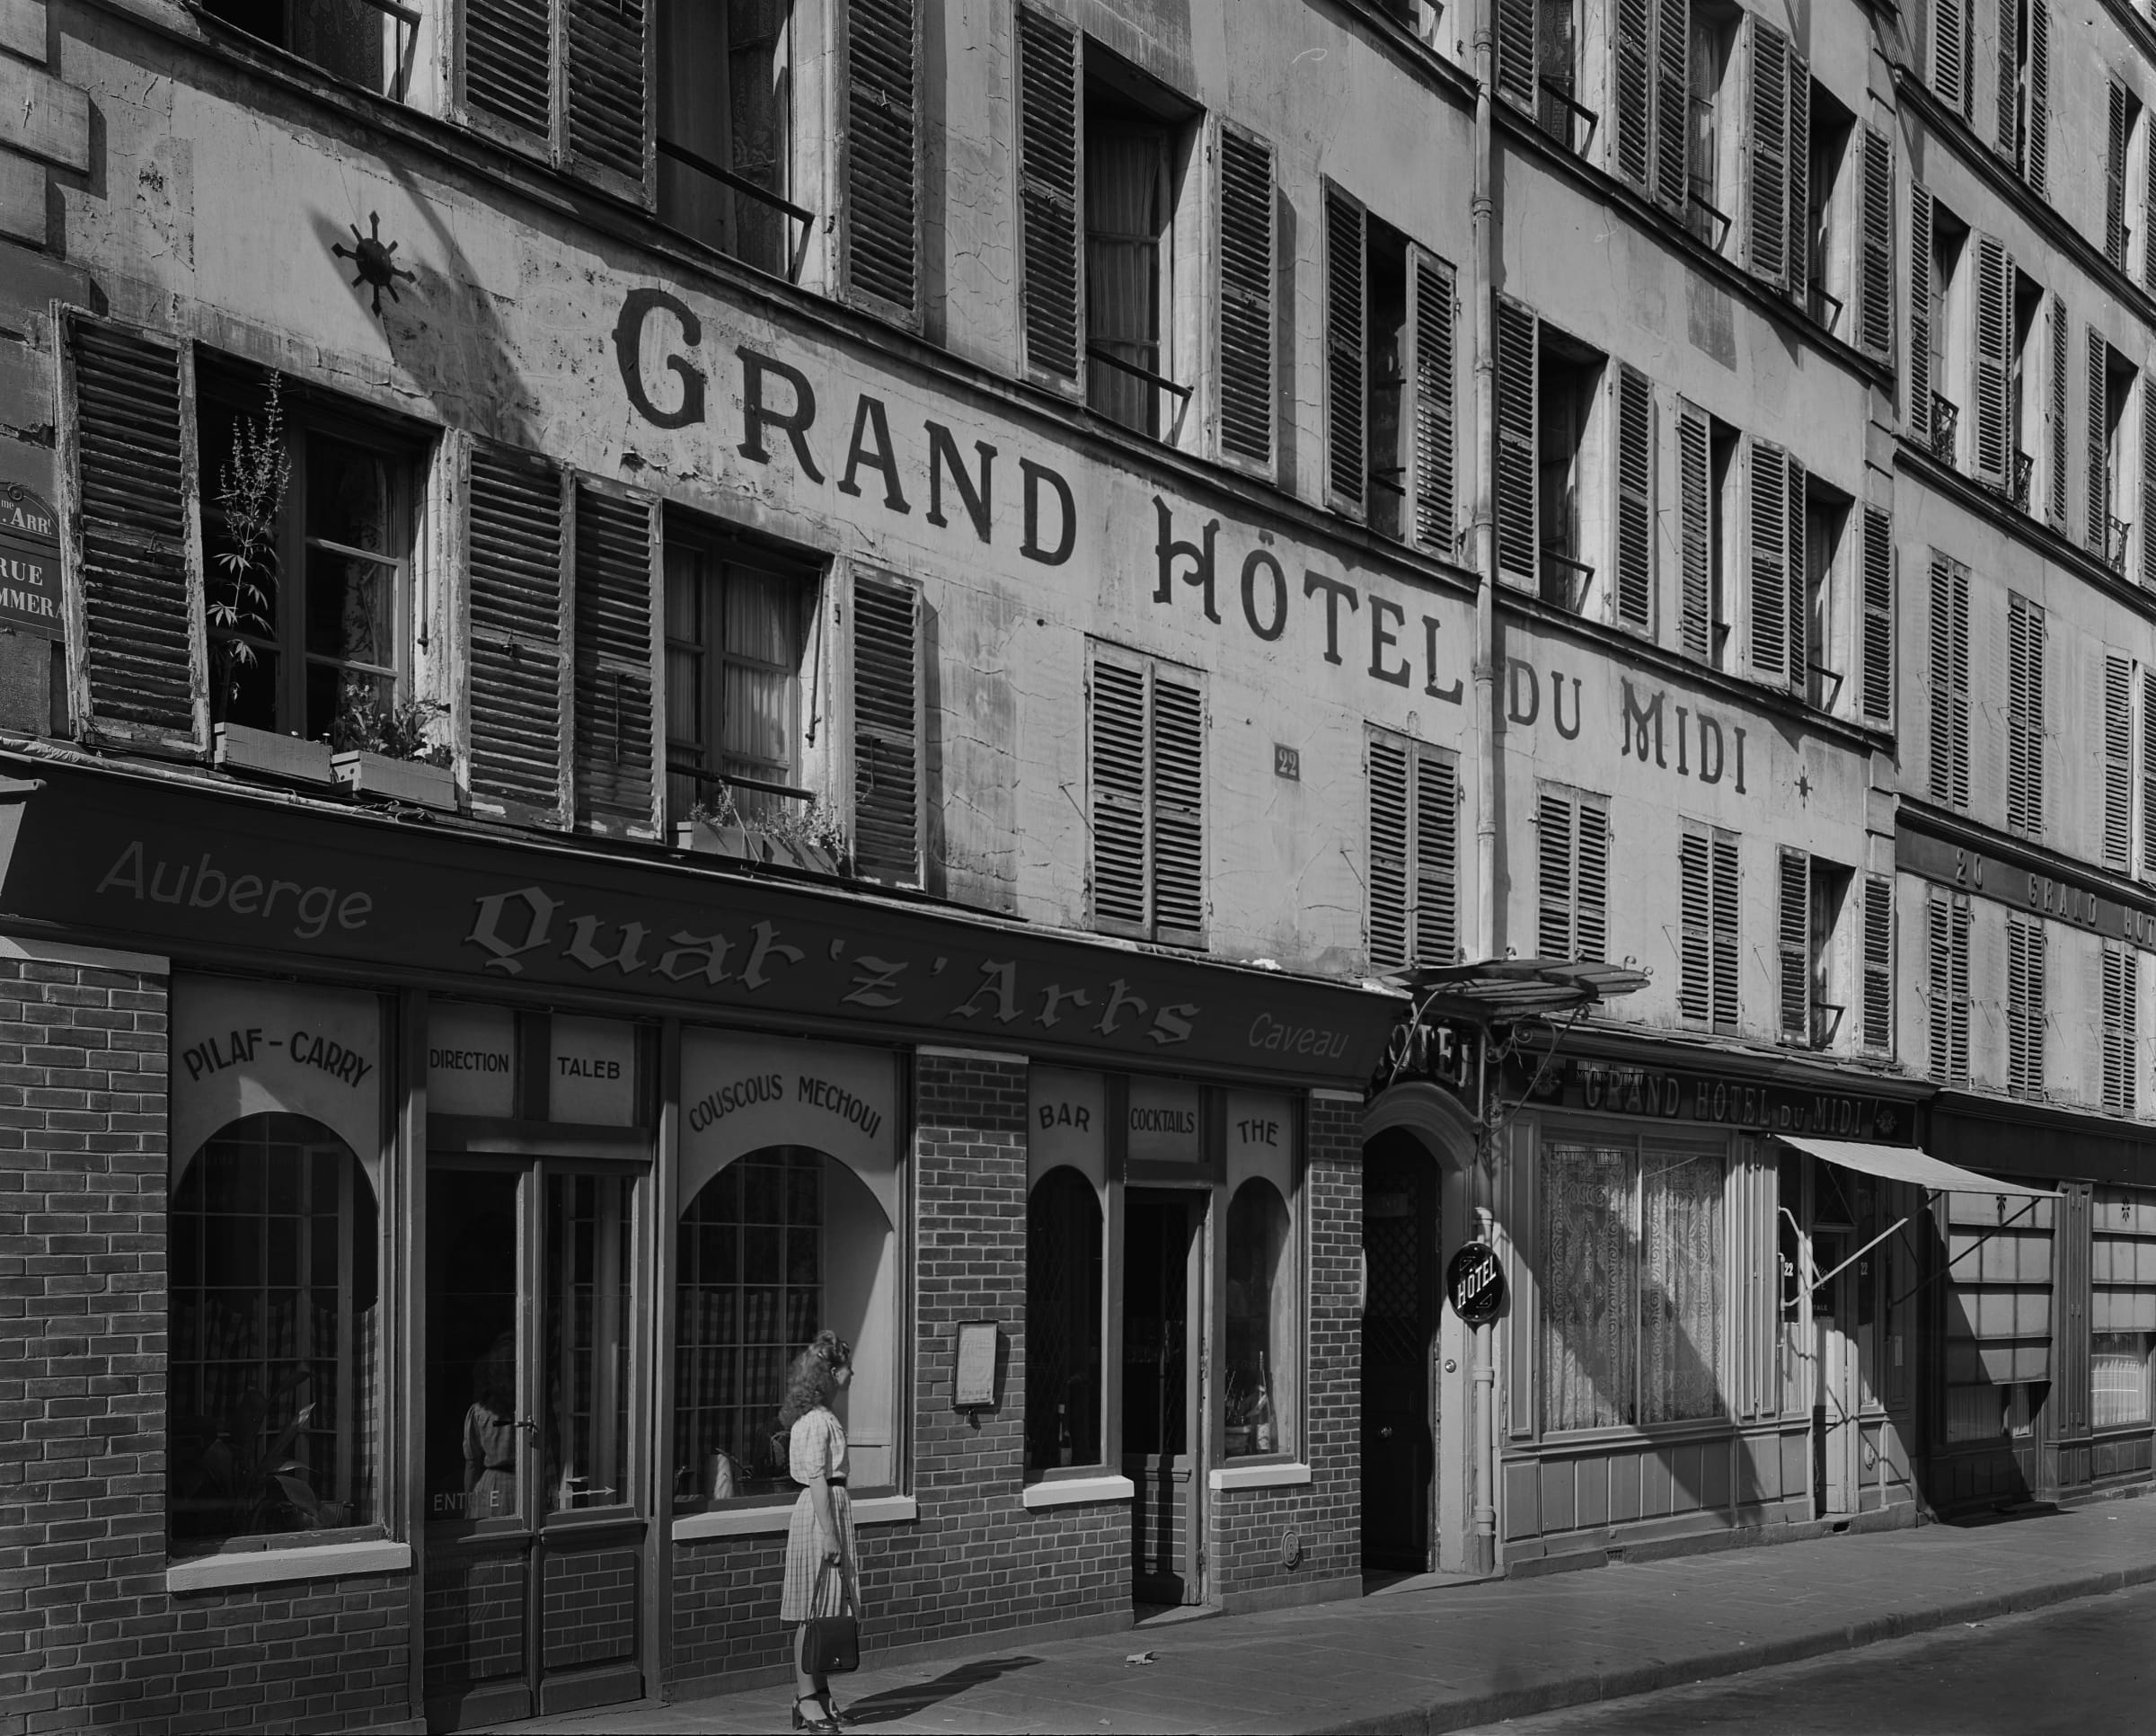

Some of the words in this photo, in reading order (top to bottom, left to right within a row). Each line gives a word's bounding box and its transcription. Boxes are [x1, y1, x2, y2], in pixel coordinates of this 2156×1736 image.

[612, 288, 1078, 566] GRAND
[1153, 494, 1463, 705] HÔTEL
[1507, 656, 1582, 740] DU
[1621, 675, 1747, 794] MIDI
[0, 557, 43, 586] RUE
[1278, 748, 1296, 776] 22
[95, 840, 372, 939] Auberge
[2028, 872, 2096, 926] GRAND
[1249, 1013, 1349, 1058] Caveau
[429, 1049, 509, 1073] DIRECTION
[557, 1057, 620, 1079] TALEB
[689, 1074, 782, 1132] COUSCOUS
[799, 1076, 881, 1138] MECHOUI
[1585, 1066, 1680, 1116] GRAND
[1780, 1104, 1804, 1129] DU
[1813, 1096, 1861, 1135] MIDI
[1038, 1102, 1091, 1133] BAR
[1130, 1108, 1195, 1134] COCKTAILS
[1784, 1262, 1794, 1277] 22
[434, 1490, 499, 1511] ENTE
